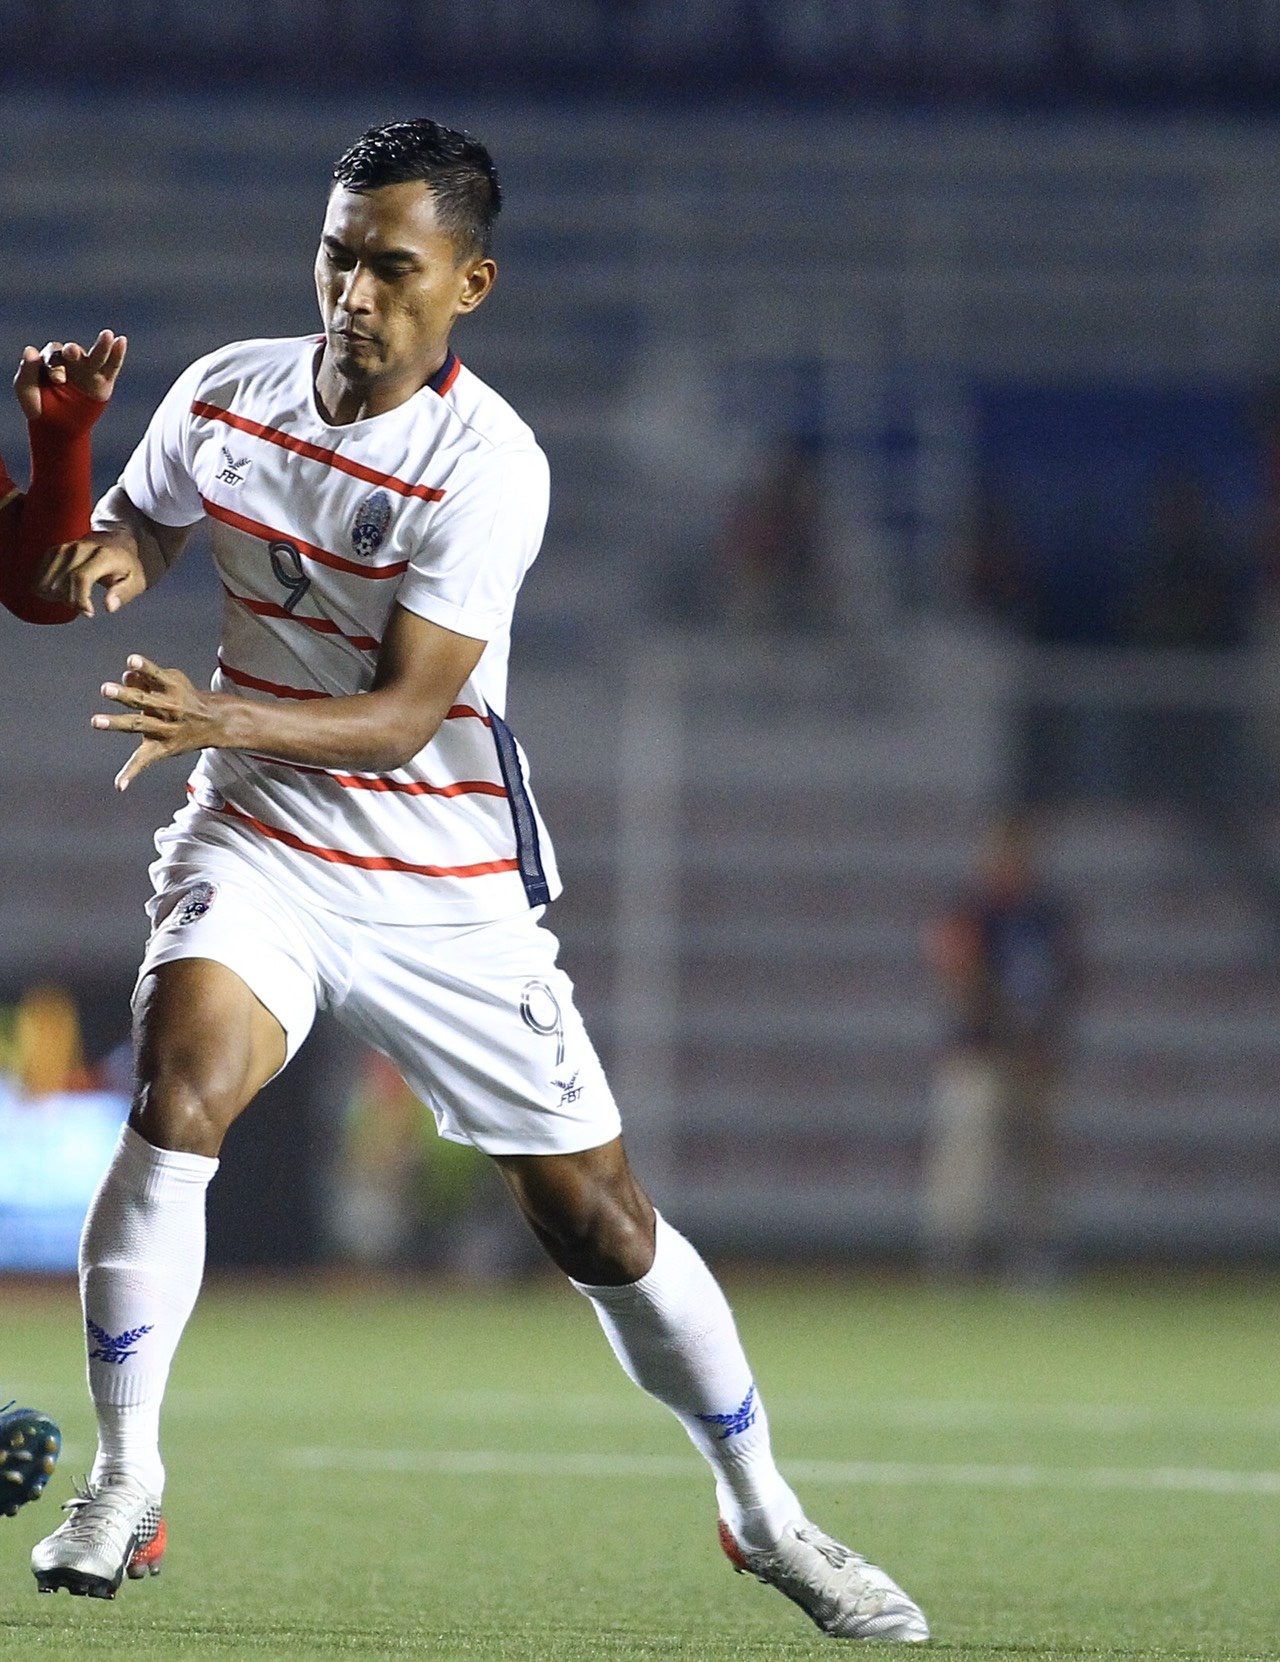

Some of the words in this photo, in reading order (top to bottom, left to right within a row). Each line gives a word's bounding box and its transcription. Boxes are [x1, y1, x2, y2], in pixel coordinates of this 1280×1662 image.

[215, 467, 244, 487] FBT
[268, 539, 311, 612] 9
[520, 980, 564, 1066] 9
[556, 1086, 584, 1108] FBT
